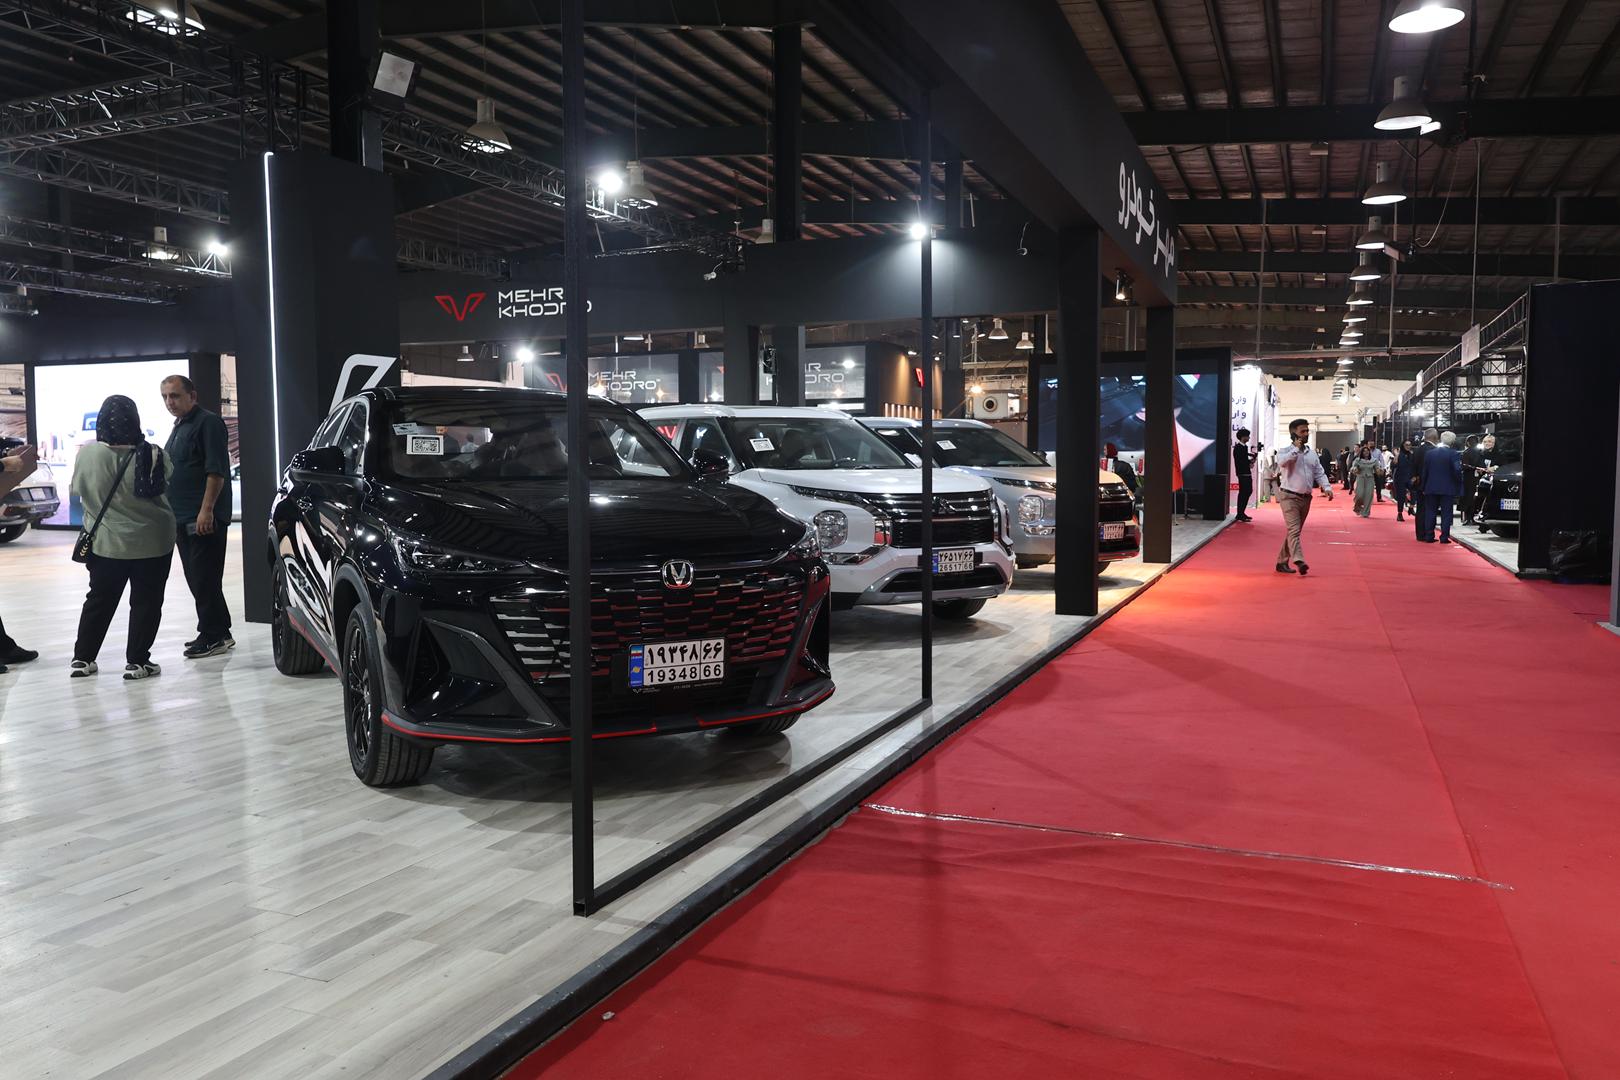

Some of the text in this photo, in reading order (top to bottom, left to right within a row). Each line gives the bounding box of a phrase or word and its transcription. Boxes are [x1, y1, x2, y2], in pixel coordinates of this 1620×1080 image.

[1118, 161, 1175, 278] مهر خودرو
[498, 287, 564, 304] MEHR
[498, 300, 593, 319] KHOD
[588, 370, 637, 381] MEHR
